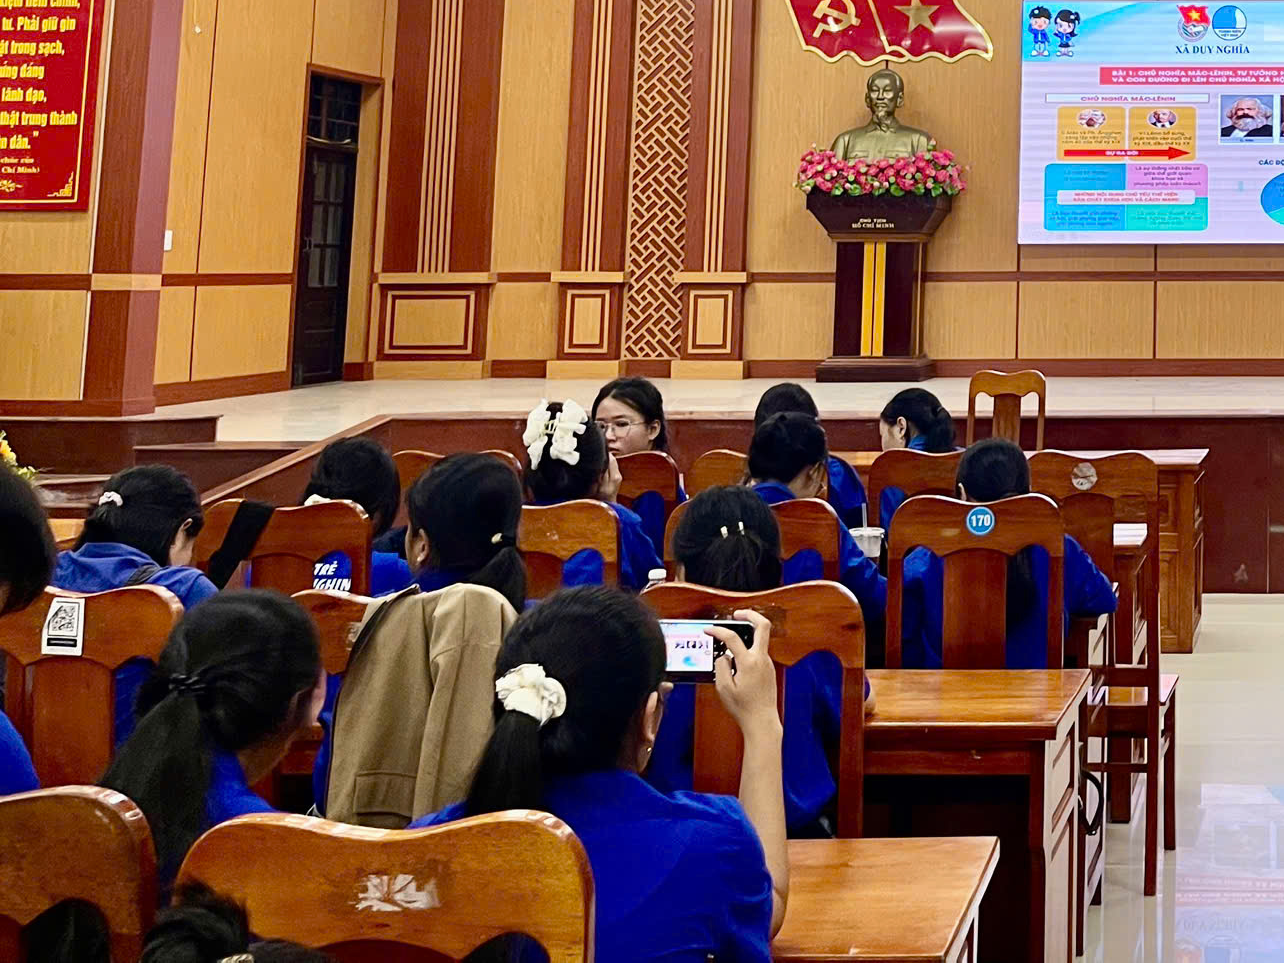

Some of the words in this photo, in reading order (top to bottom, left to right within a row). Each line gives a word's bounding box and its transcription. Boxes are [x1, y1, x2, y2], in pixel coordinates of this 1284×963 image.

[10, 40, 37, 56] trong
[1192, 45, 1213, 54] DUY
[21, 111, 48, 127] trung
[50, 110, 78, 126] thành
[971, 514, 991, 527] 170
